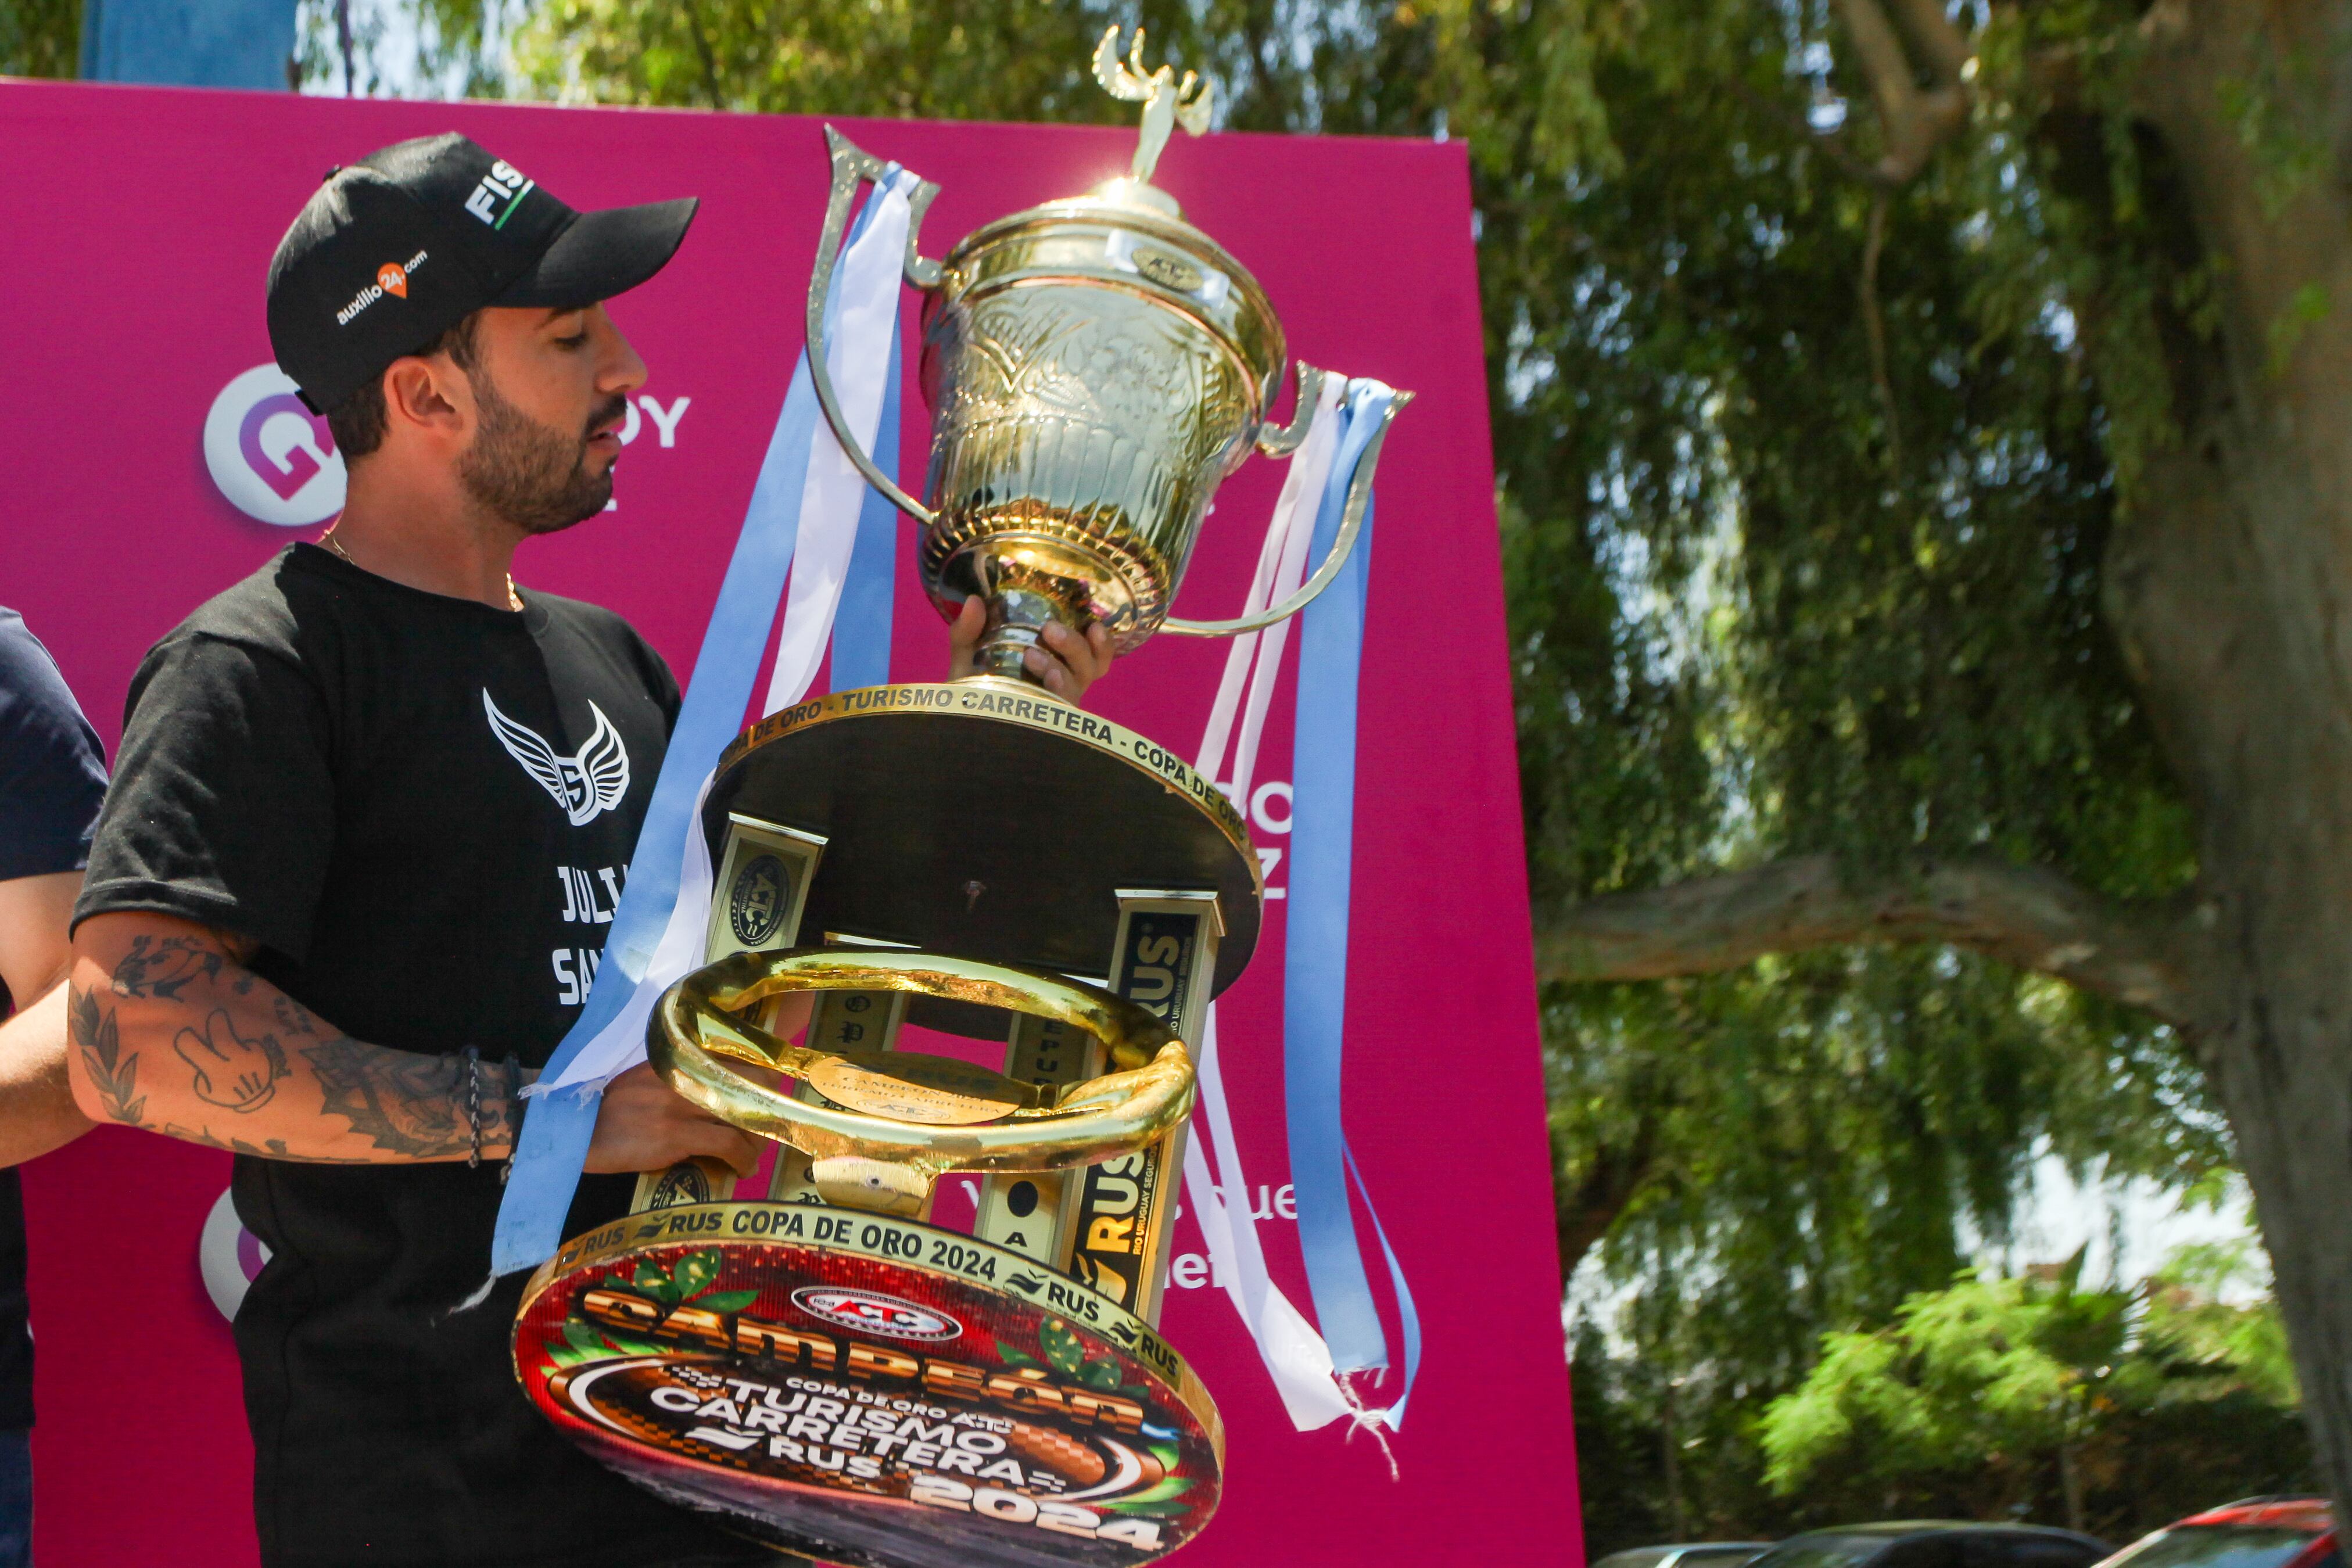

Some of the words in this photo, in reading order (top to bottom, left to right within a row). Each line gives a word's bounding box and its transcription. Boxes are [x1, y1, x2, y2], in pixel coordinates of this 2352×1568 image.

[755, 719, 776, 742] DE
[780, 701, 822, 728] ORO
[842, 689, 952, 711] TURISMO
[962, 691, 1113, 744] CARRETERA
[1134, 740, 1186, 785] COPA
[1192, 776, 1215, 807] DE
[1085, 1150, 1145, 1254] RUS
[1137, 1190, 1152, 1236] URUGUAY
[583, 1227, 625, 1255] RUS
[668, 1212, 724, 1233] RUS
[732, 1210, 804, 1237] COPA
[813, 1217, 853, 1244] DE
[861, 1225, 922, 1258] ORO
[930, 1241, 996, 1282] 2024
[1048, 1281, 1100, 1322] RUS
[1141, 1334, 1178, 1377] RUS
[650, 1386, 1025, 1486] CARRETERA
[726, 1378, 1007, 1455] TURISMO
[786, 1377, 850, 1400] COPA
[856, 1390, 889, 1406] DE
[893, 1400, 947, 1419] ORO
[770, 1436, 881, 1479] RUS
[910, 1474, 1164, 1551] 2024
